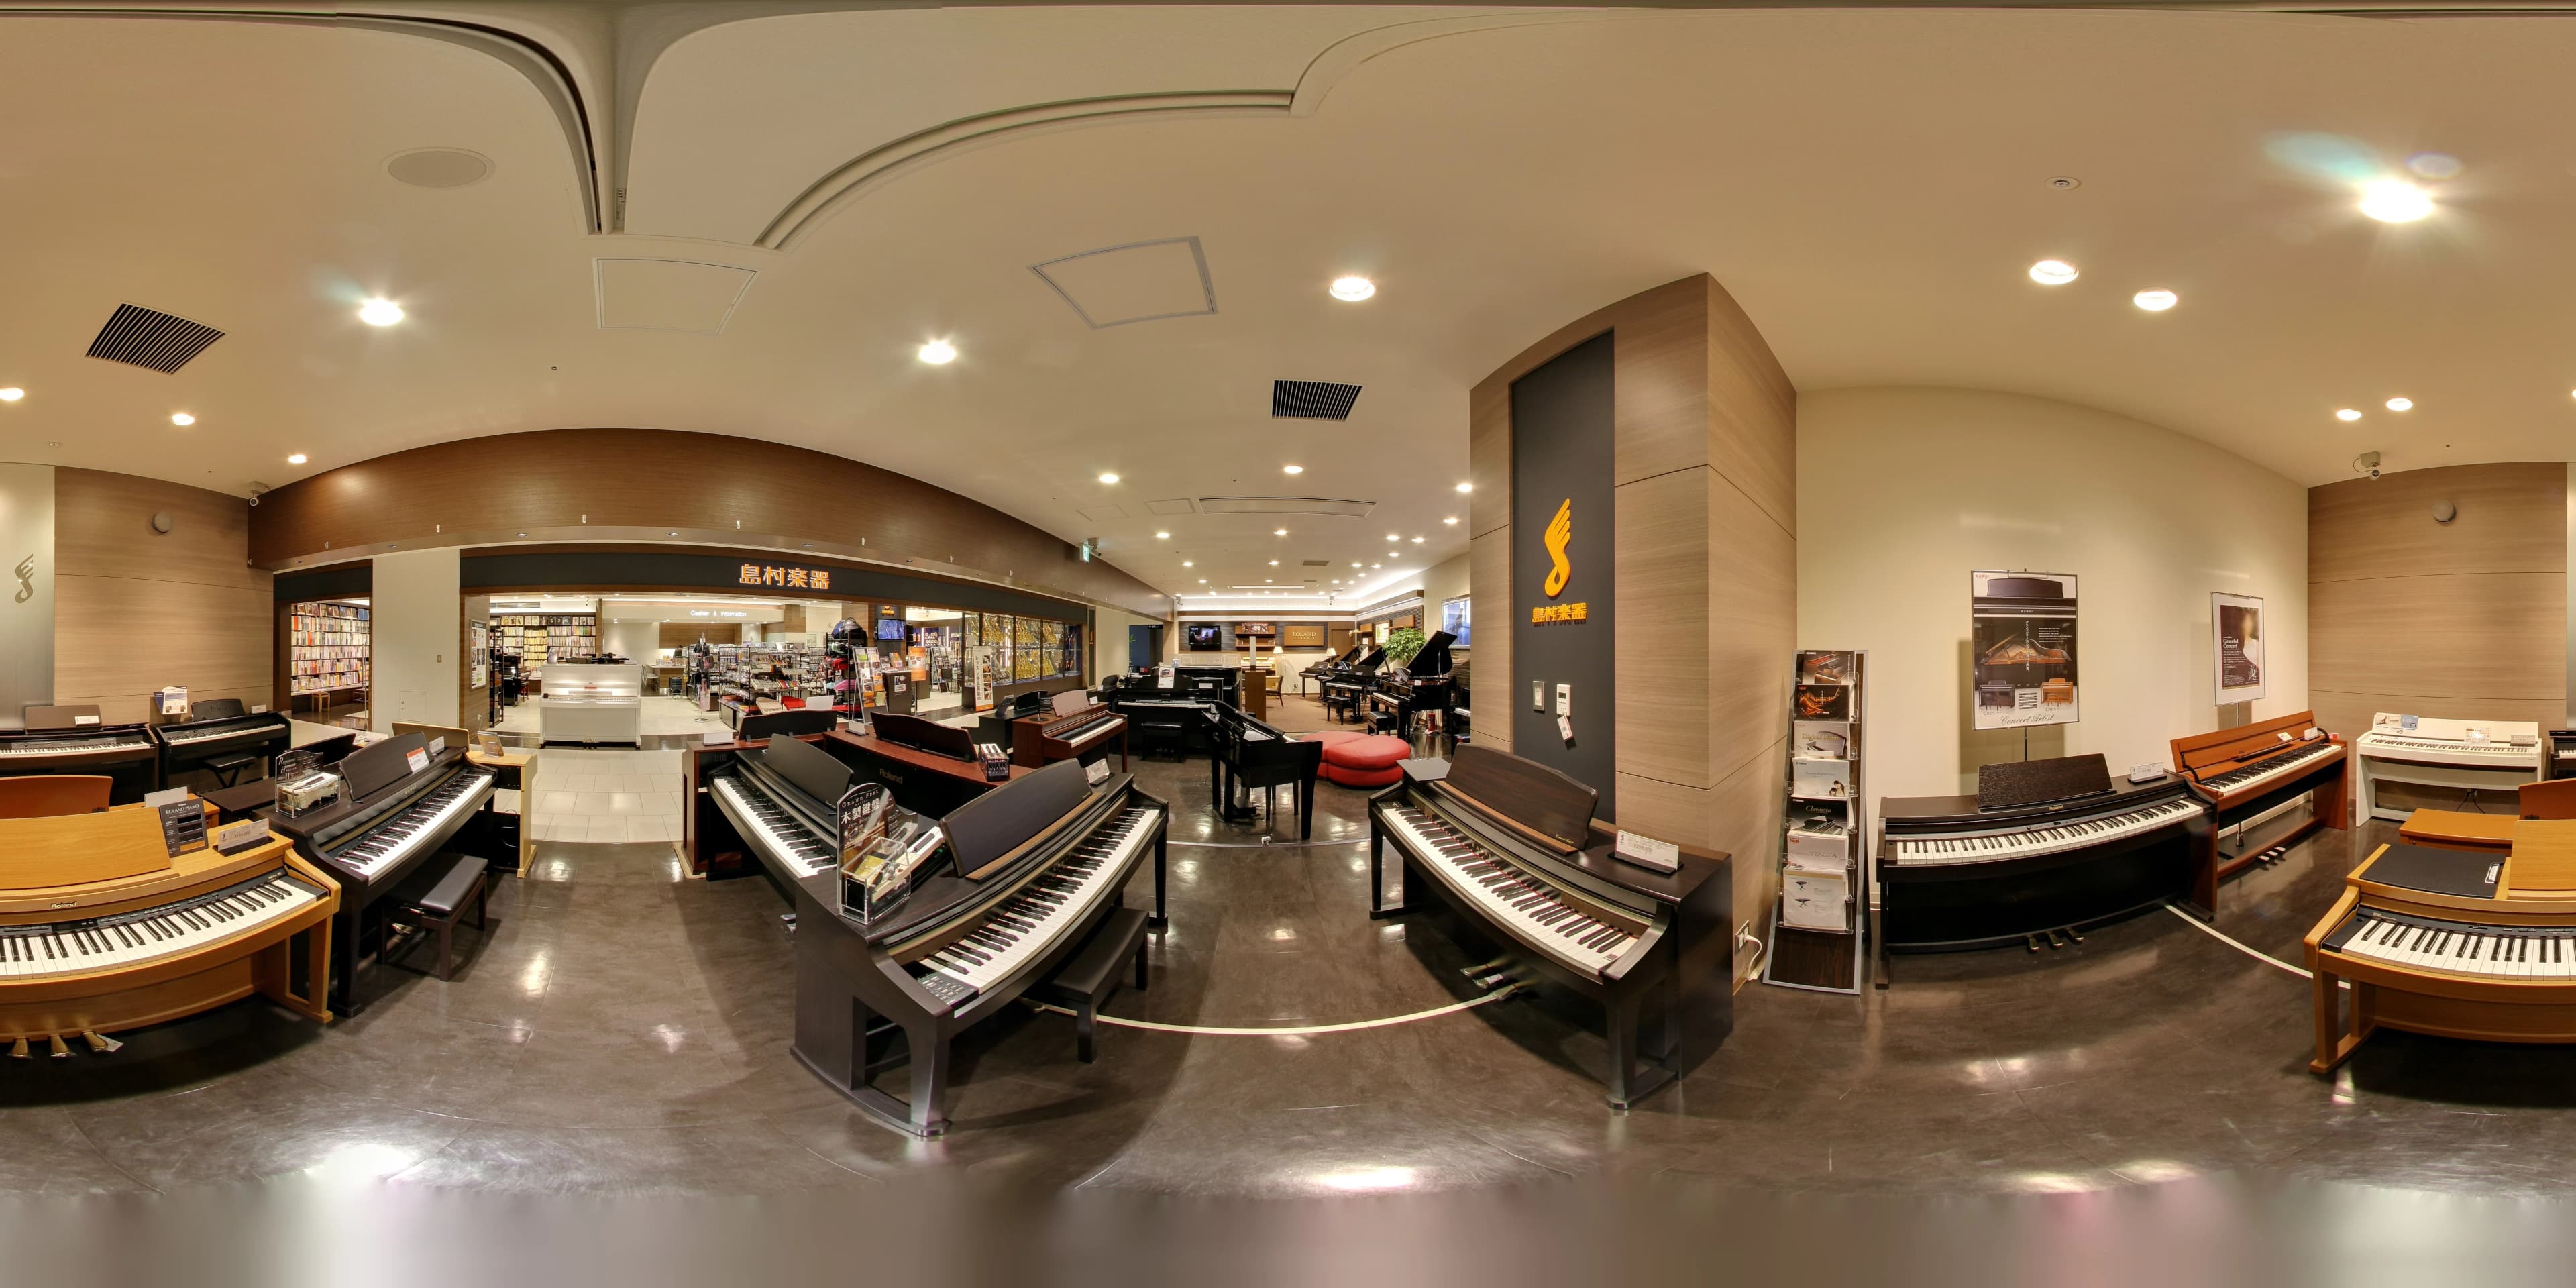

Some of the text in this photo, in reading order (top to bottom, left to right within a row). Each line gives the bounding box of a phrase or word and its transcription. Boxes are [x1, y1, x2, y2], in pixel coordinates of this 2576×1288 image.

[739, 563, 830, 590] 島村楽器
[1532, 602, 1587, 623] 島村楽器
[2000, 713, 2055, 724] Concert Artist
[879, 768, 903, 784] Roland
[842, 796, 863, 808] GRAND
[865, 790, 879, 798] FEEL
[166, 806, 185, 815] ROLAND
[841, 798, 880, 824] 木製鍵盤
[1805, 805, 1831, 813] Clavinova
[51, 901, 77, 909] Roland
